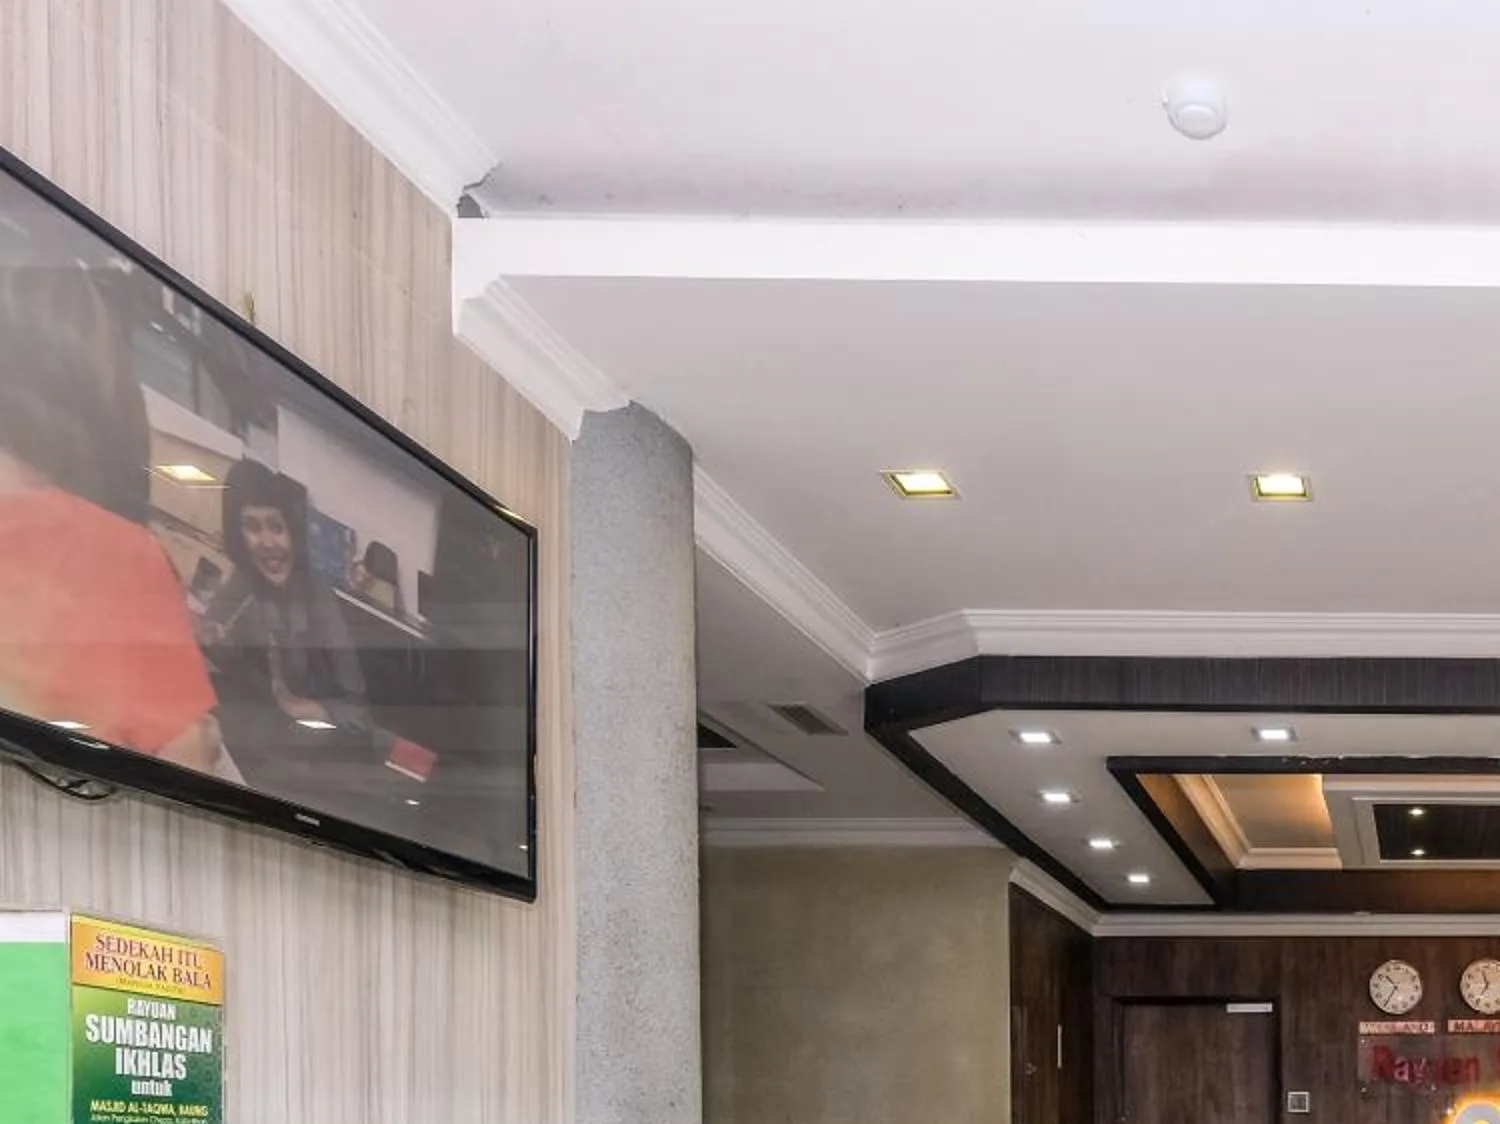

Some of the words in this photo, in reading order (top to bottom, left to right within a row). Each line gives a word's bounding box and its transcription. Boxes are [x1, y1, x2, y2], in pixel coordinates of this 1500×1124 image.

[95, 933, 174, 964] SEDEKAH
[84, 951, 168, 982] MENOLAK
[172, 967, 213, 991] BALA
[127, 998, 177, 1020] RAYUAN
[85, 1013, 213, 1054] SUMBANGAN
[115, 1047, 187, 1080] IKHLAS
[131, 1079, 173, 1097] untuk
[90, 1099, 127, 1113] MASJID
